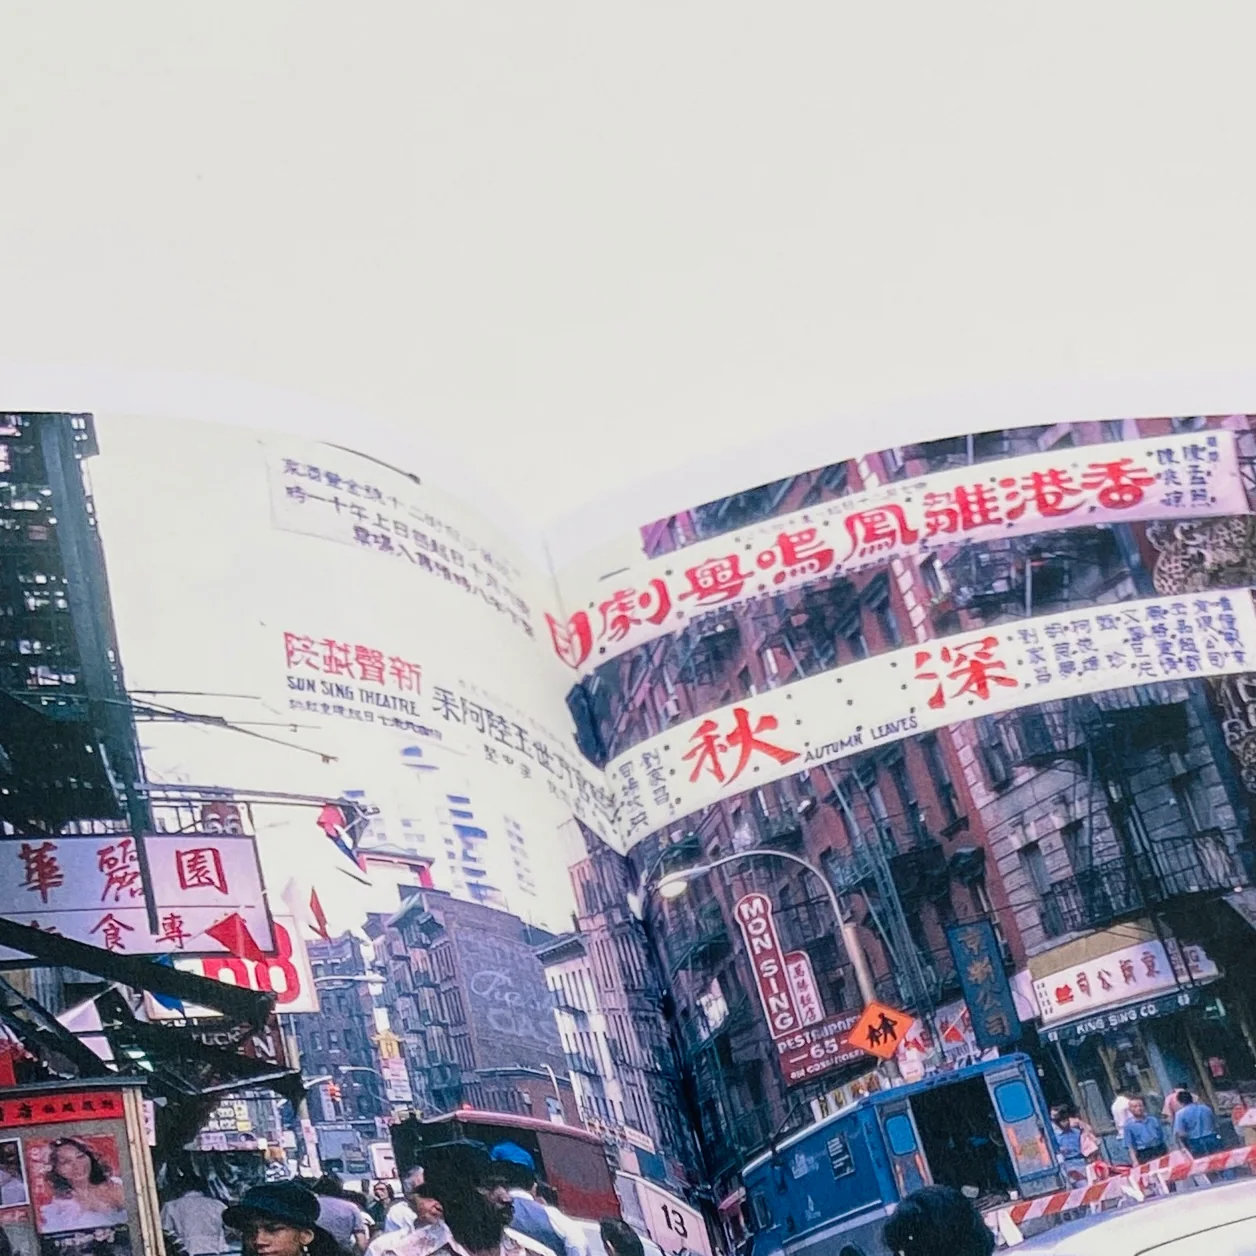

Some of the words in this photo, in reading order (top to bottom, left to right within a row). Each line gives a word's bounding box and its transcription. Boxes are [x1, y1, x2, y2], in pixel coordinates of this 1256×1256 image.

[286, 676, 316, 693] SUN
[321, 680, 354, 701] SING
[359, 688, 421, 717] THEATRE
[804, 733, 864, 764] AUTUMN
[871, 715, 918, 741] LEAVES
[739, 898, 773, 955] MON
[759, 958, 795, 1031] SING
[1077, 1017, 1105, 1034] KING
[1109, 1009, 1137, 1026] SING
[810, 1038, 839, 1059] 65
[661, 1204, 688, 1239] 13
